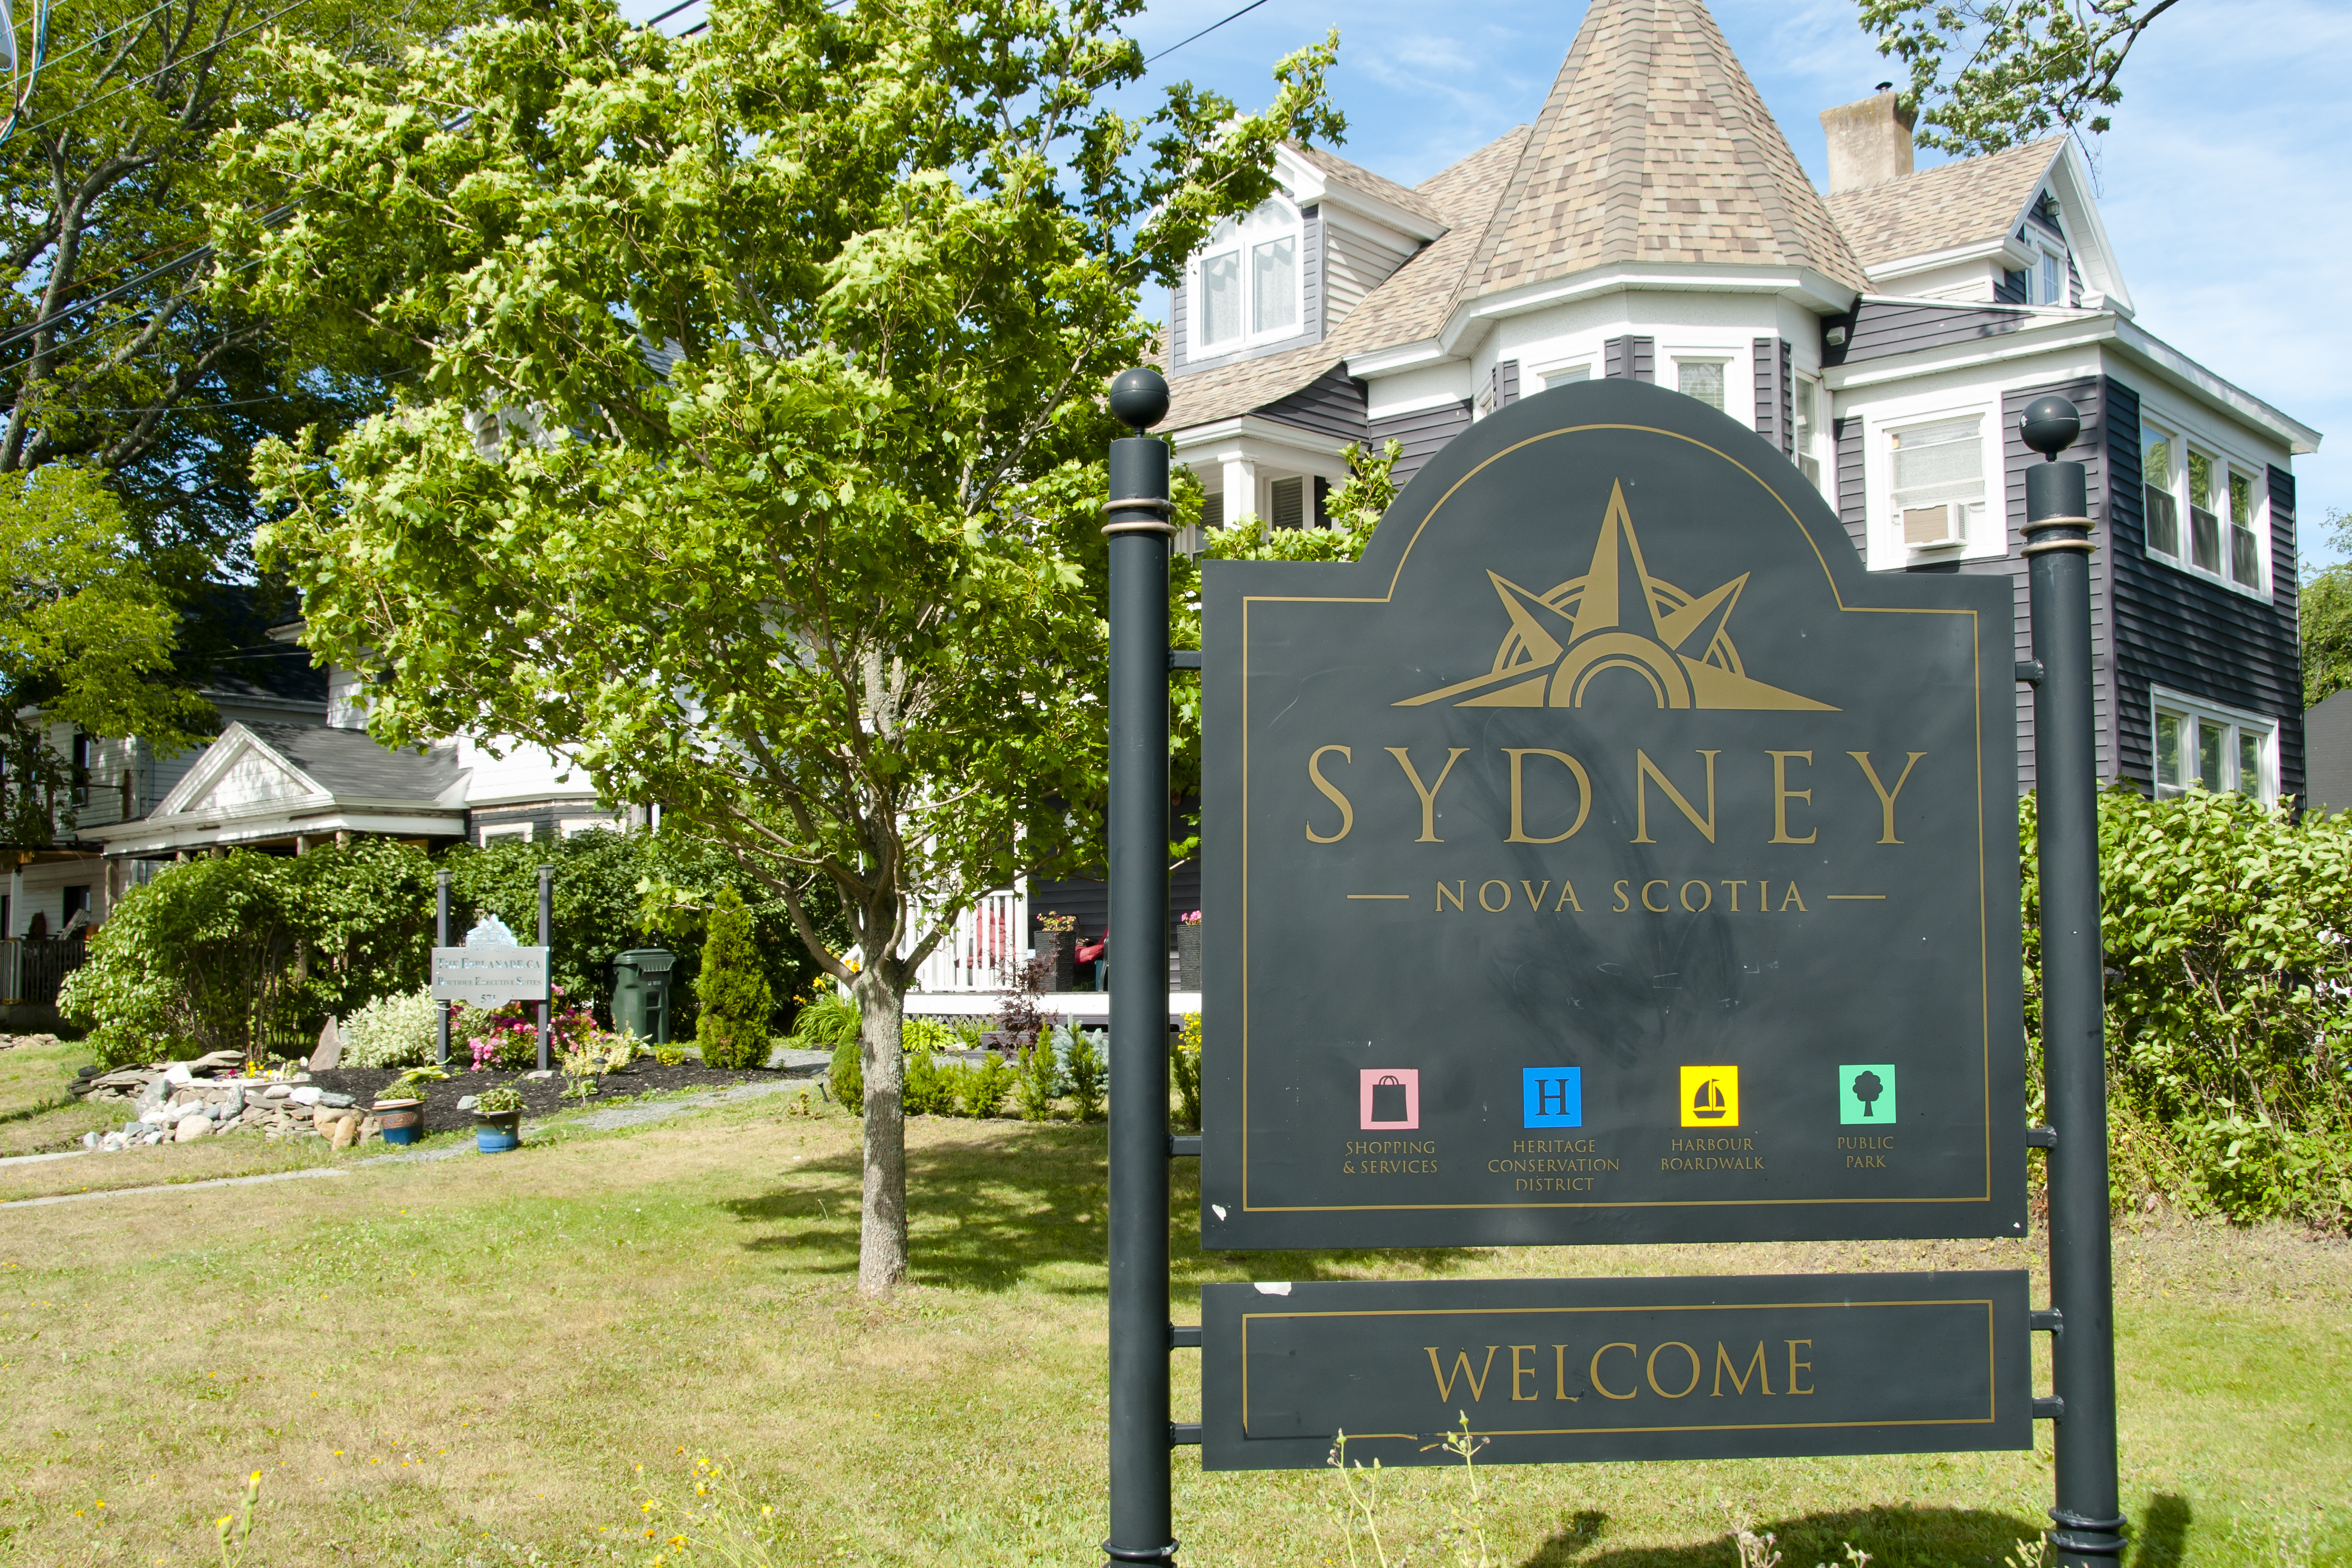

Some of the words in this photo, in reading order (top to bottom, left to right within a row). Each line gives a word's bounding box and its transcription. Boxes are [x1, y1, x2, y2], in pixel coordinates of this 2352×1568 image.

[1306, 744, 1927, 845] SYDNEY
[1435, 879, 1584, 913] NOVA
[1613, 879, 1808, 913] SCOTIA
[1345, 1140, 1436, 1155] SHOPPING
[1512, 1140, 1595, 1154] HERITAGE
[1671, 1137, 1754, 1152] HARBOUR
[1838, 1136, 1894, 1150] PUBLIC
[1342, 1160, 1355, 1174] &
[1361, 1160, 1438, 1174] SERVICES
[1488, 1158, 1619, 1173] CONSERVATION
[1661, 1156, 1765, 1171] BOARDWALK
[1846, 1154, 1887, 1169] PARK
[1515, 1178, 1594, 1192] DISTRICT
[1424, 1338, 1815, 1404] WELCOME
